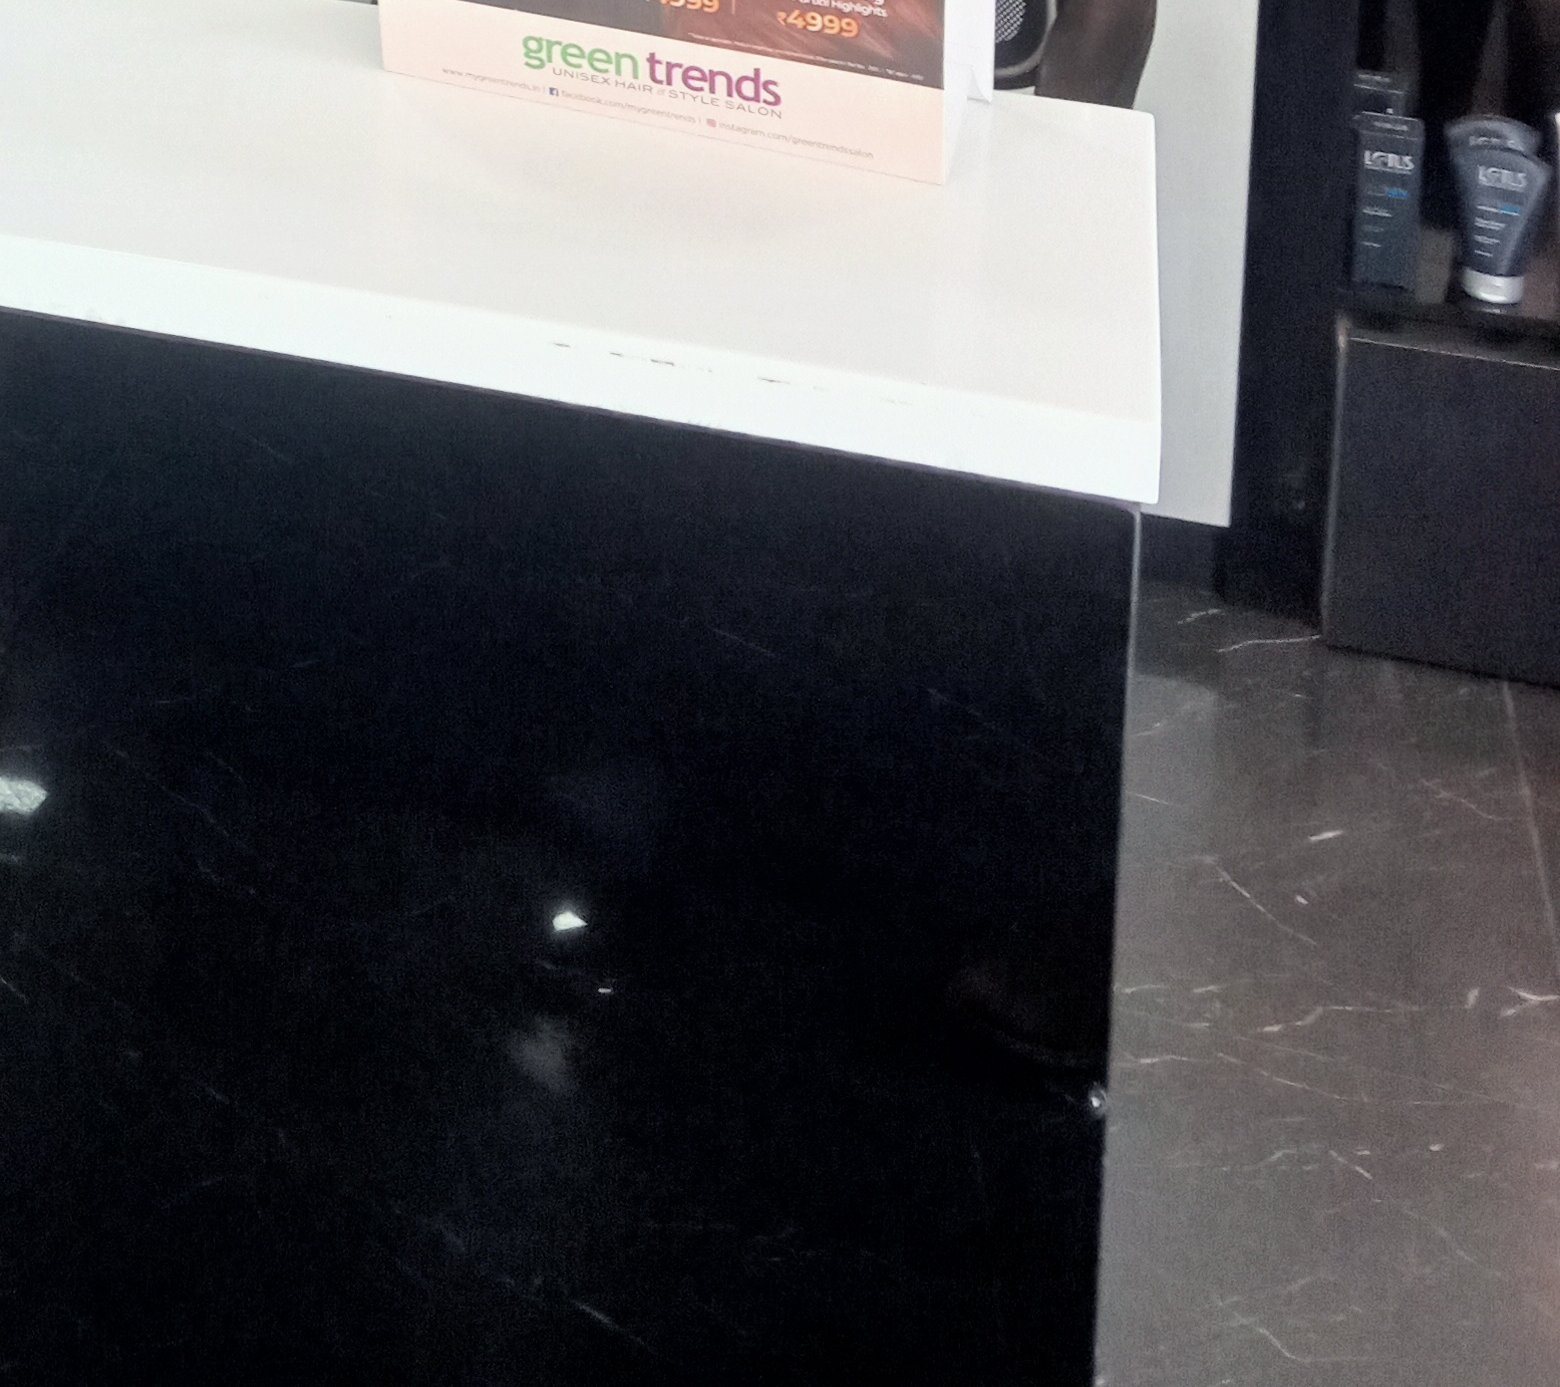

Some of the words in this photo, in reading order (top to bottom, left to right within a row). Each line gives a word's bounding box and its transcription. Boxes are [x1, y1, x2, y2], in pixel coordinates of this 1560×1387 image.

[831, 0, 888, 18] Highlights
[522, 35, 640, 80] green
[646, 51, 782, 107] trends
[552, 67, 611, 86] UNISEX
[614, 79, 653, 94] HAIR
[668, 88, 720, 107] STYLE
[724, 101, 782, 119] SALON
